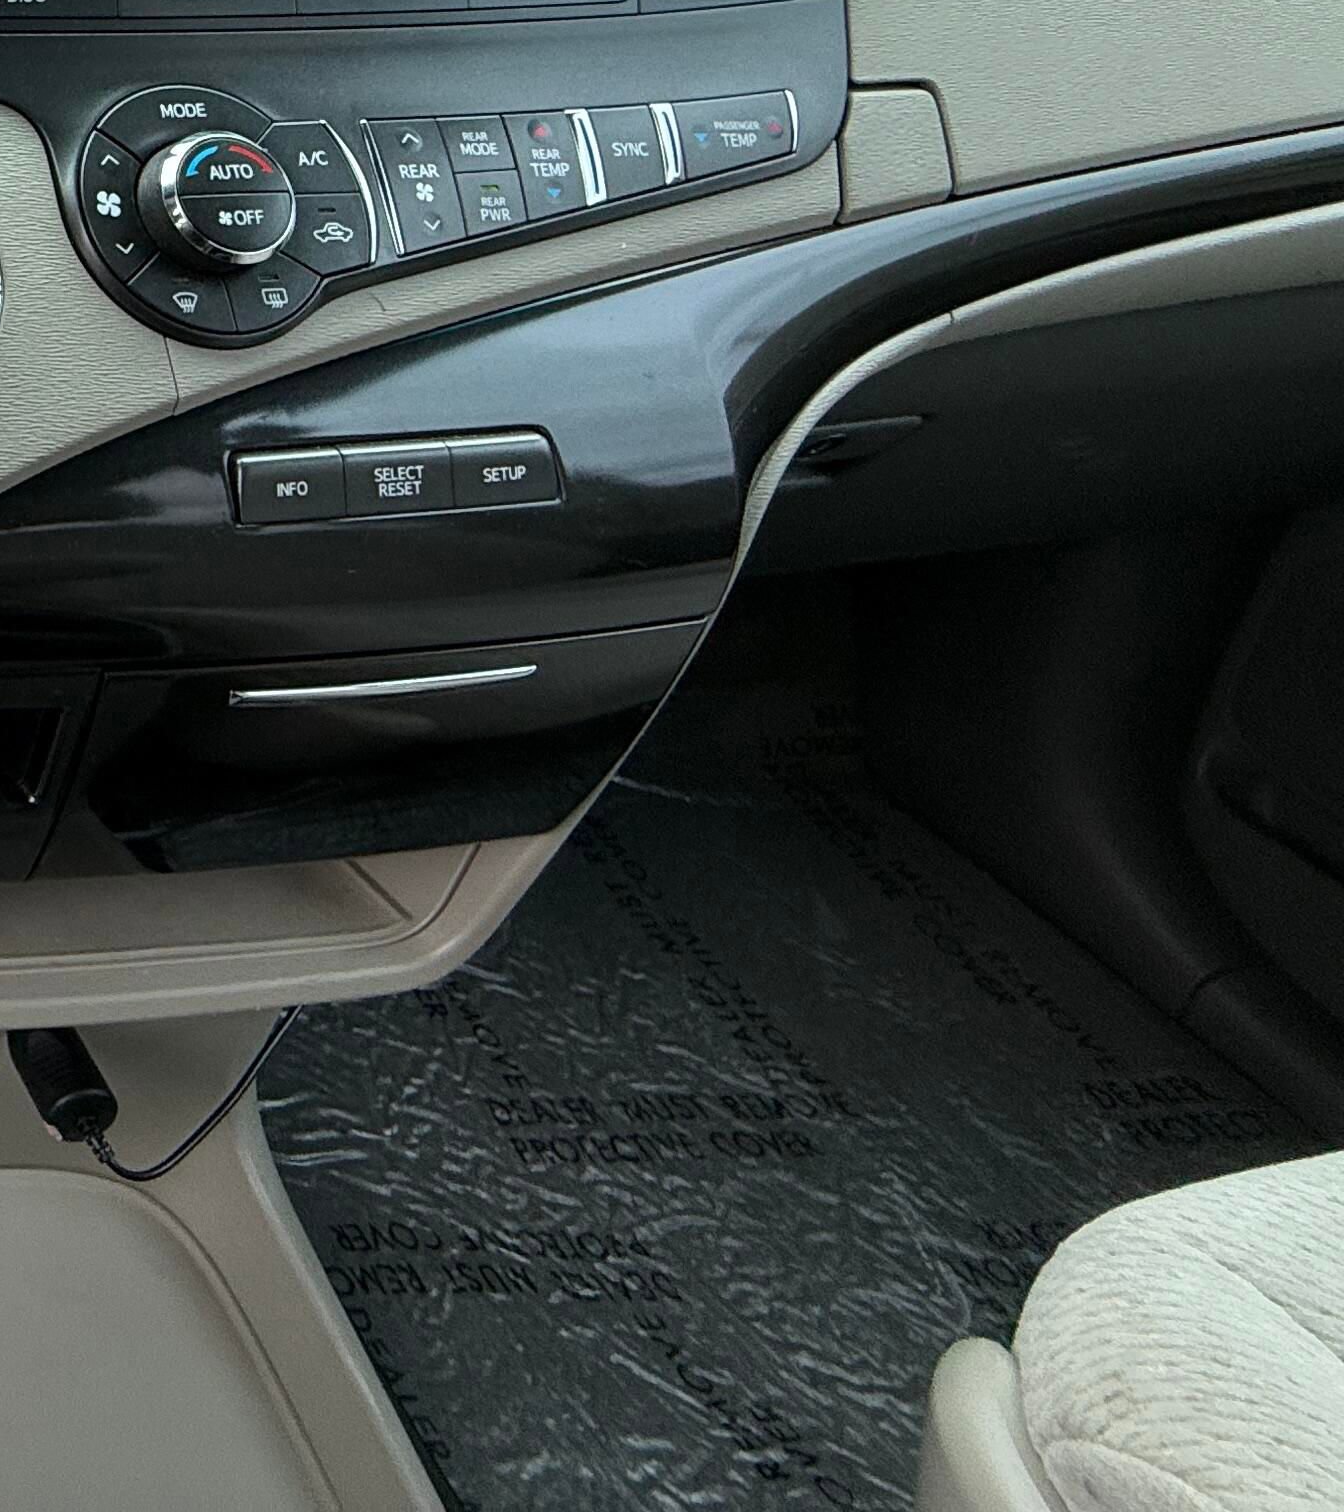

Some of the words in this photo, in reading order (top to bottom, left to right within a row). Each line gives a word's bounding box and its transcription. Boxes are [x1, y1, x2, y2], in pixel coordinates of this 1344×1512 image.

[160, 103, 207, 119] MODE
[713, 120, 760, 132] PASSENGER
[461, 131, 488, 142] REAR
[720, 132, 758, 149] TEMP
[459, 141, 499, 157] MODE
[531, 148, 561, 160] REAR
[611, 141, 649, 157] SYNC
[298, 150, 329, 167] A/C
[209, 164, 254, 181] AUTO
[399, 163, 440, 179] REAR
[529, 161, 570, 178] TEMP
[480, 196, 506, 207] REAR
[234, 209, 265, 226] OFF
[480, 207, 512, 222] PWR
[373, 465, 424, 481] SELECT
[482, 465, 527, 485] SETUP
[276, 481, 309, 498] INFO
[378, 480, 422, 497] RESET
[325, 1263, 427, 1298] REMO
